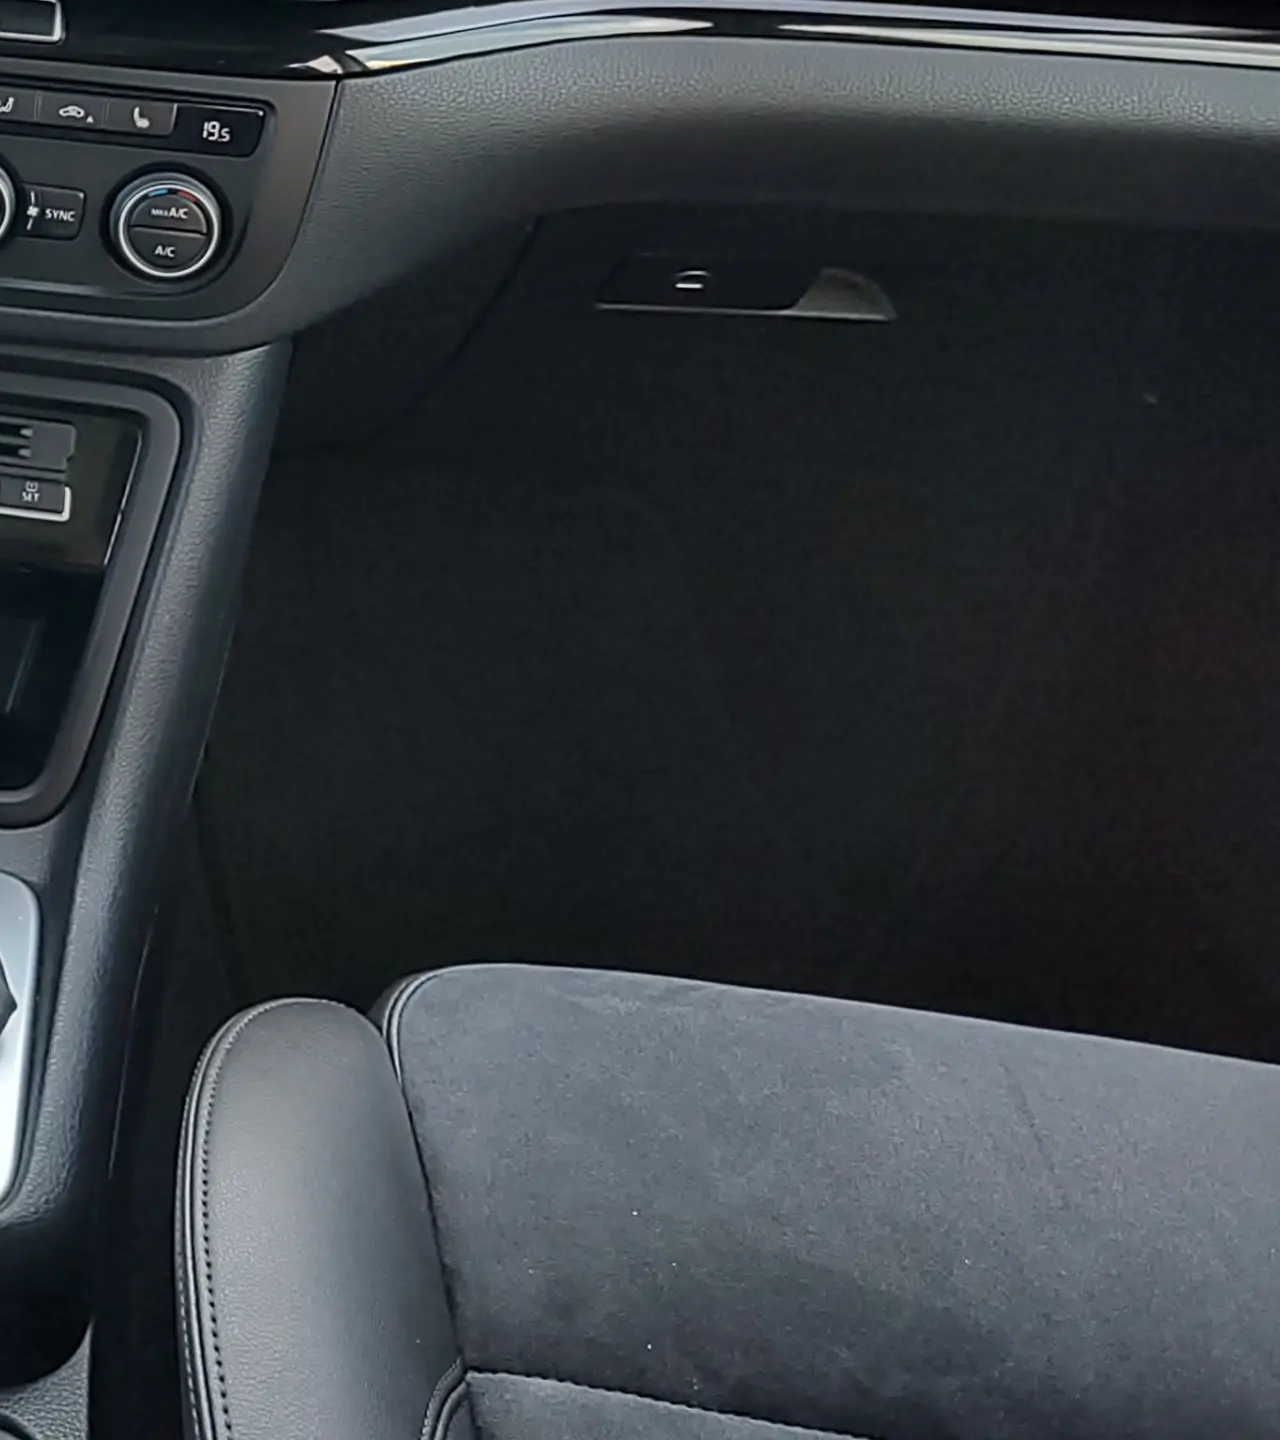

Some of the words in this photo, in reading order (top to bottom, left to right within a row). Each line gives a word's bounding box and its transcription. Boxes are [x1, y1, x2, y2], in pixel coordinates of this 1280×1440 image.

[202, 121, 231, 142] 19.5
[44, 208, 75, 222] SYNC
[154, 246, 176, 258] A/C
[22, 491, 40, 503] SET
